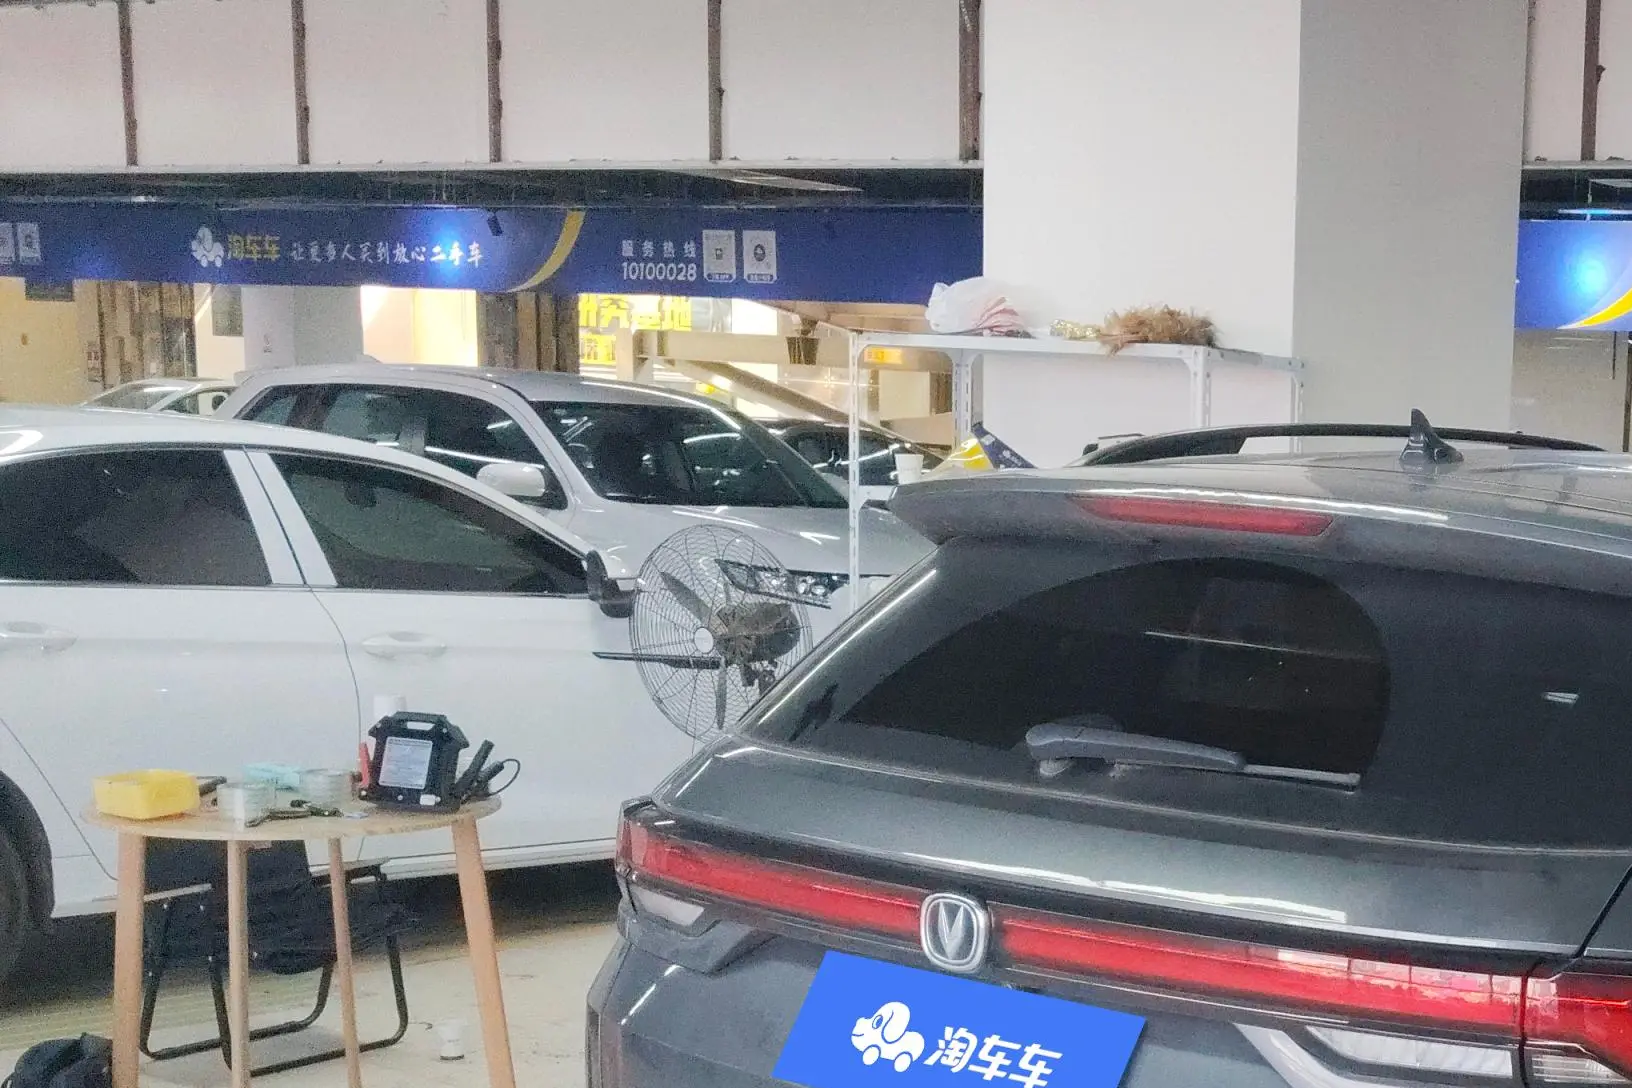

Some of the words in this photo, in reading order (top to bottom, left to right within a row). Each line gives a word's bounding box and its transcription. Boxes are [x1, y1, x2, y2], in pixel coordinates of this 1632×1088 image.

[621, 239, 697, 258] 服务热线
[621, 261, 698, 281] 10100028
